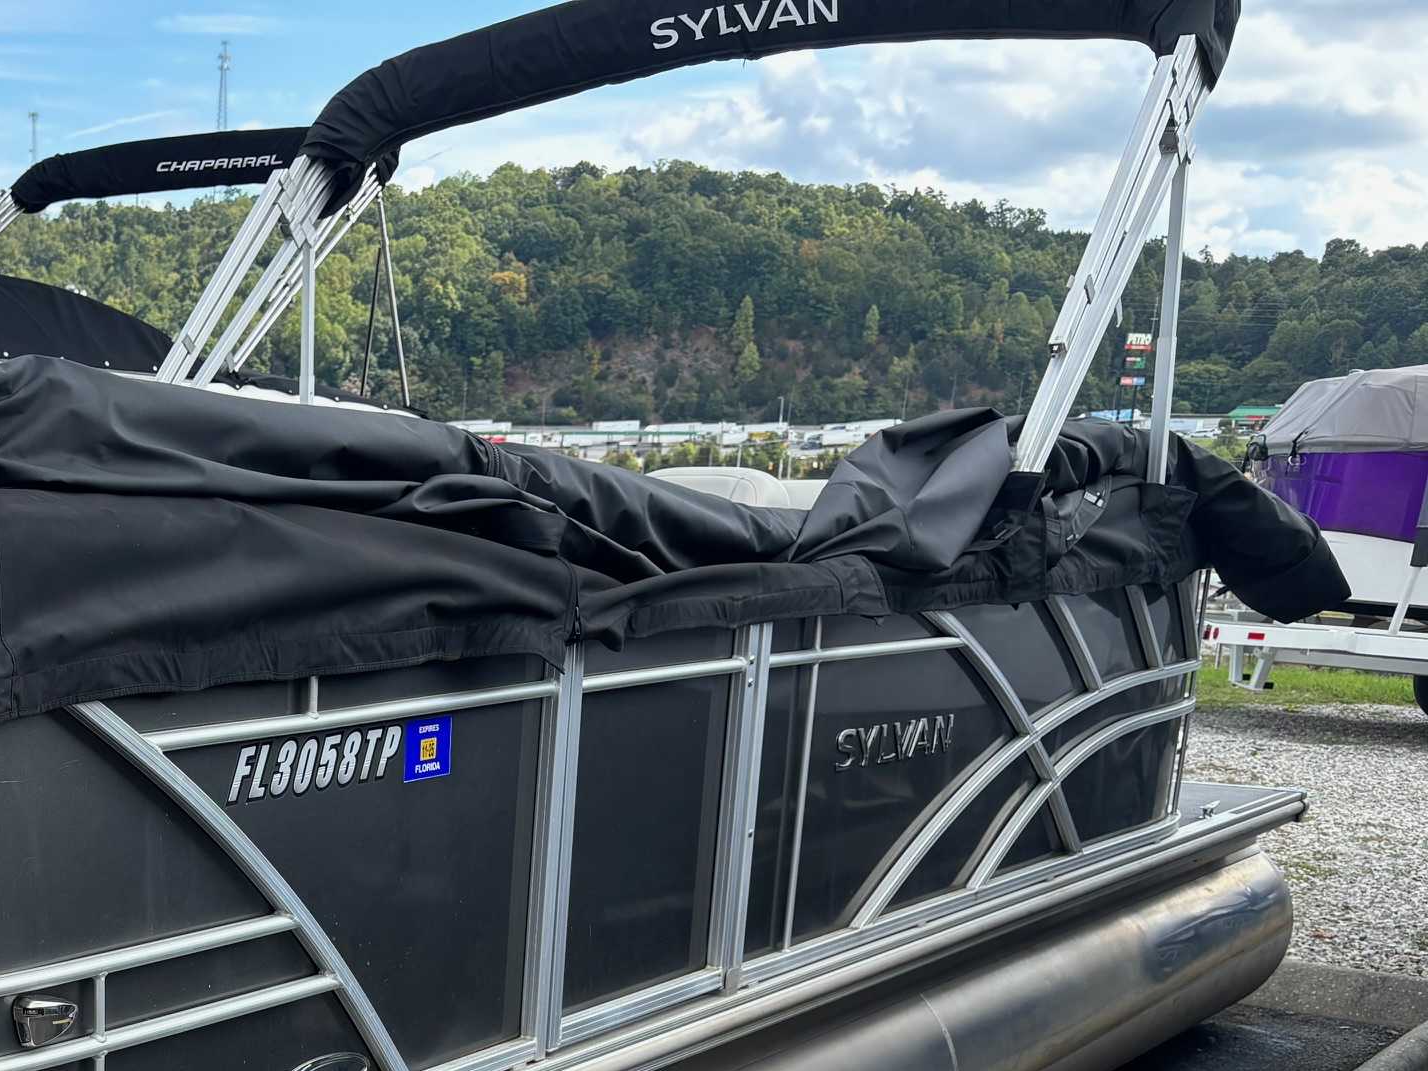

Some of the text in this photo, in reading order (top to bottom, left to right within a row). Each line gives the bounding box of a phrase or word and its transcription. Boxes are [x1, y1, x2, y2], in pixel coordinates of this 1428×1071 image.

[650, 0, 839, 50] SYLVAN
[156, 154, 283, 172] CHAPARRAL
[1127, 333, 1152, 345] PETRO
[835, 714, 953, 771] SYLVAN
[227, 725, 402, 803] FL3058TP
[415, 762, 440, 774] FLORIDA
